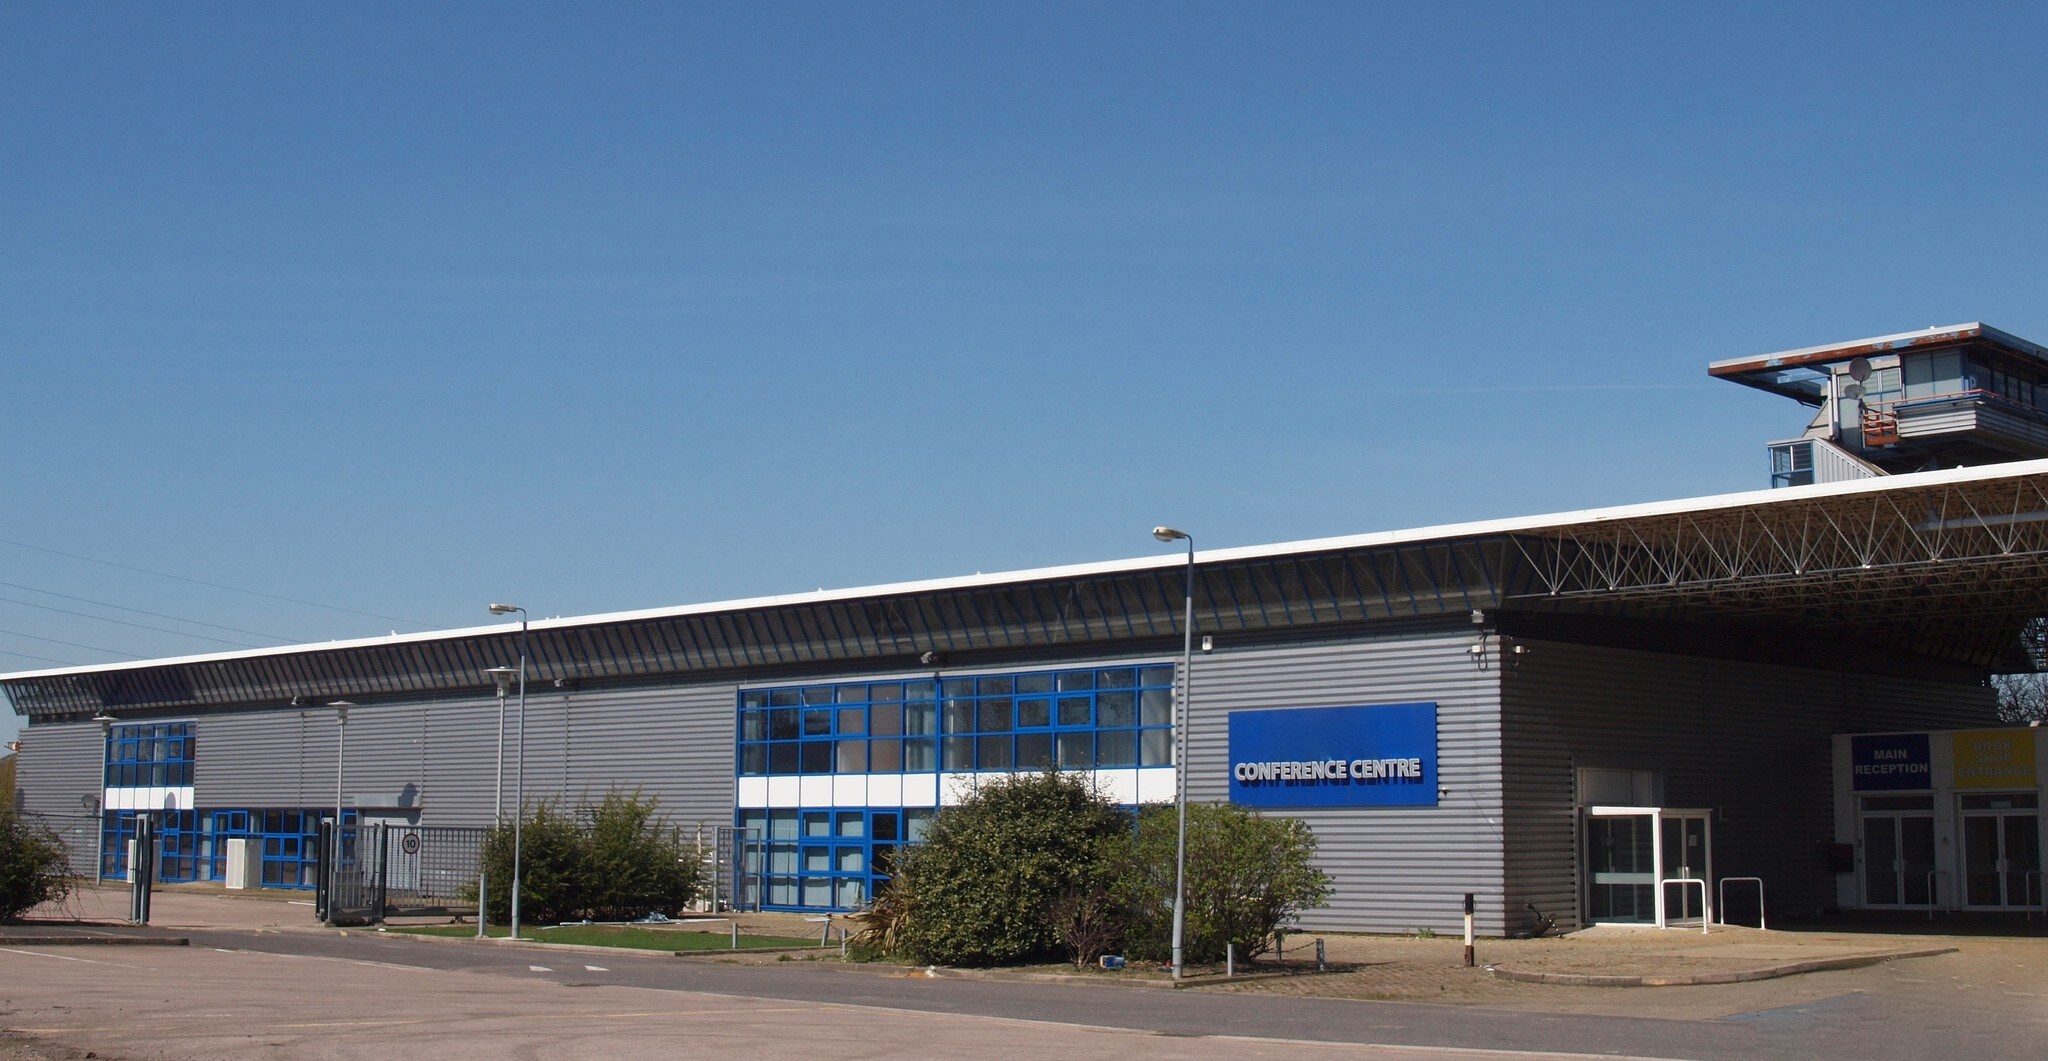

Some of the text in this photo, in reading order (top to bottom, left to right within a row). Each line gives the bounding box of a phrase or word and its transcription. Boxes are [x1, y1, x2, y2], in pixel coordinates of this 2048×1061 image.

[1973, 741, 2013, 751] BOOK
[1874, 749, 1907, 760] MAIN
[1975, 753, 2012, 764] SHOP
[1235, 758, 1421, 781] CONFERENCE CENTRE
[1855, 763, 1928, 775] RECEPTION
[1958, 766, 2031, 778] ENTRANCE
[406, 839, 416, 848] 10
